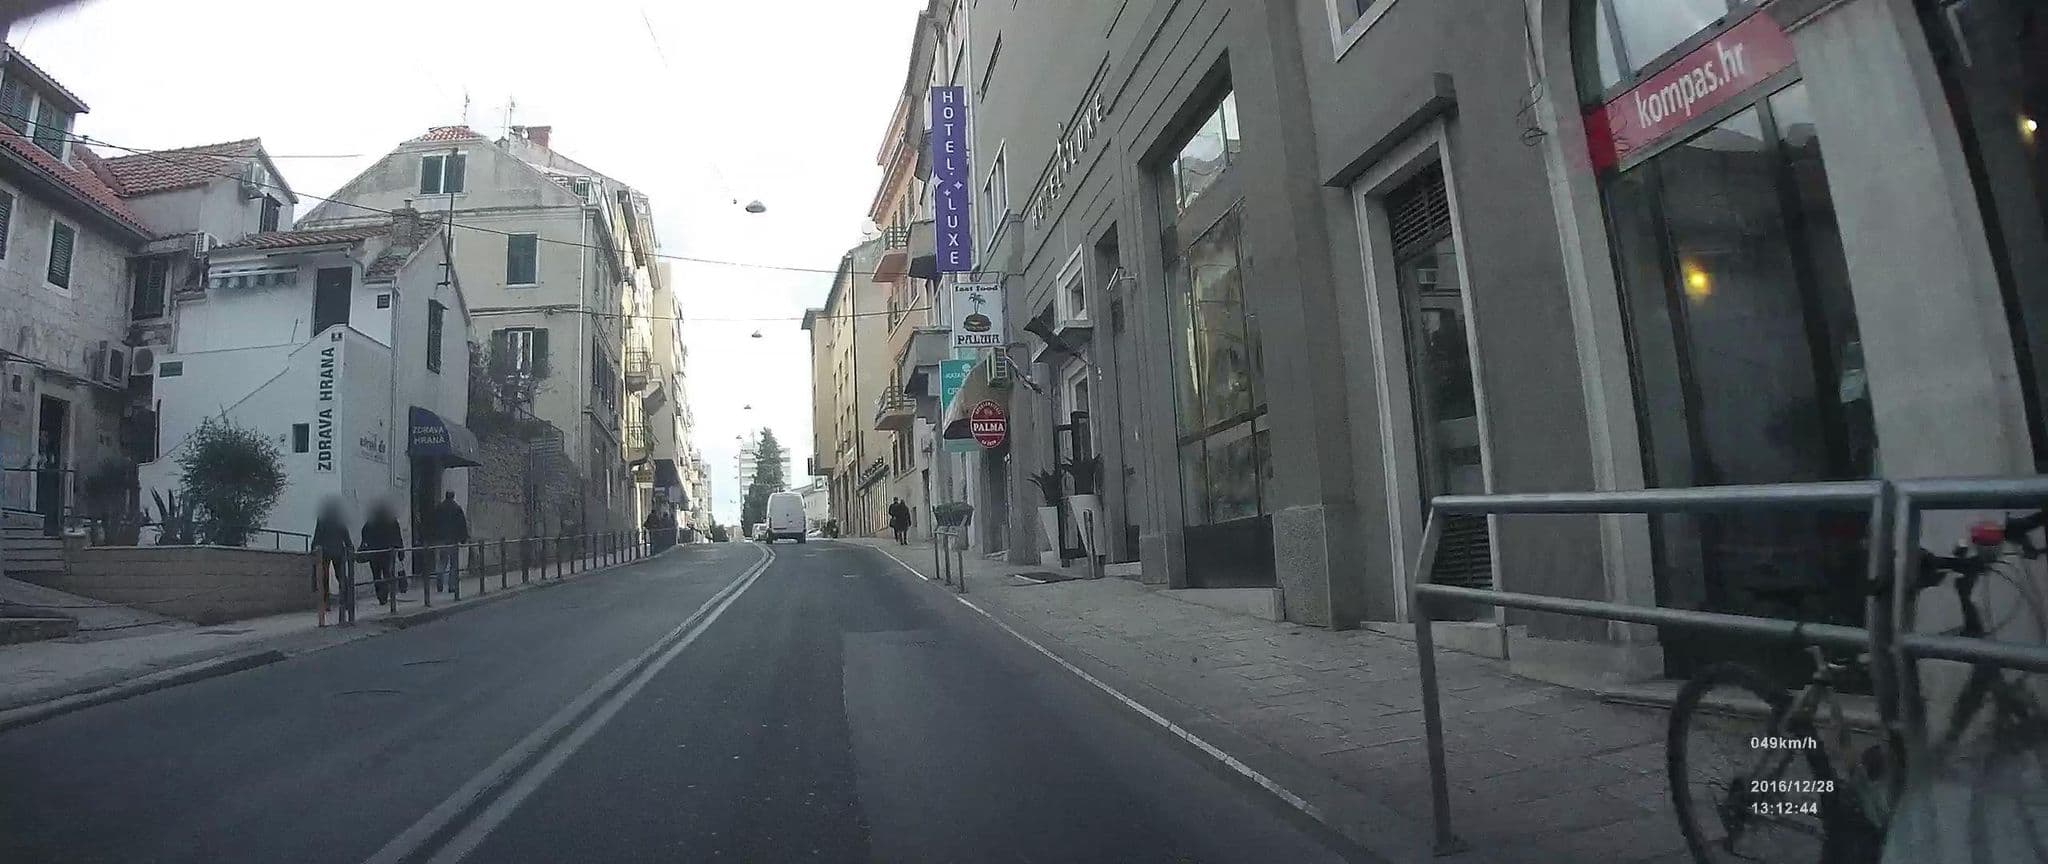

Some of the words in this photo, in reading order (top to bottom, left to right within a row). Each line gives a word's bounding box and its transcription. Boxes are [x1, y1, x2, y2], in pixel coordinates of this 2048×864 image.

[1633, 40, 1745, 129] kompas.hr
[942, 91, 955, 170] HOTEL
[1031, 164, 1065, 231] HOTEL
[1070, 93, 1106, 165] LUXE
[948, 198, 960, 265] LUXE
[957, 334, 1001, 345] PALMA
[319, 347, 335, 401] HRANA
[318, 408, 333, 471] ZDRAVA
[412, 426, 445, 434] ZDRAVA
[414, 436, 446, 445] HRANA
[973, 422, 1004, 432] PALMA
